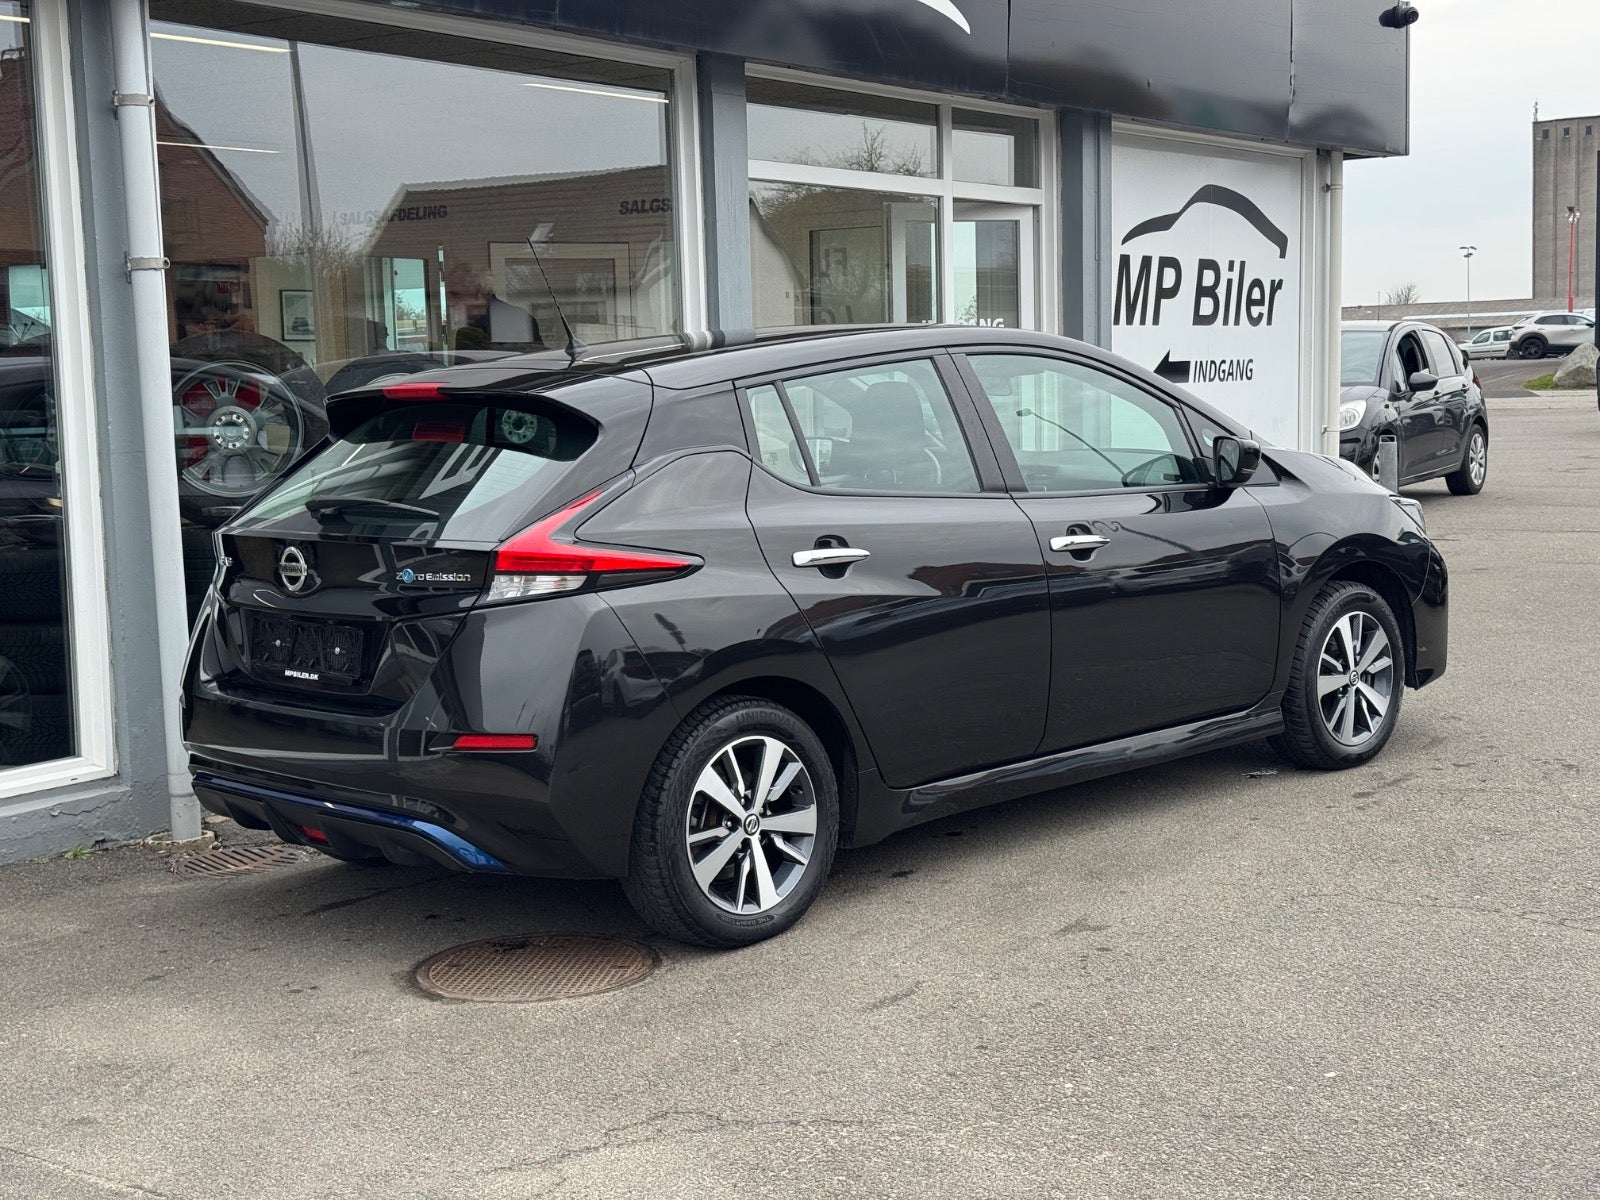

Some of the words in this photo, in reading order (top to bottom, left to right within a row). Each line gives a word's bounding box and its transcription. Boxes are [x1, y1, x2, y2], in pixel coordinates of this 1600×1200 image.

[1113, 254, 1183, 326] MP
[1192, 258, 1284, 327] Biler
[1193, 358, 1254, 383] INDGANG
[426, 572, 471, 582] Emission
